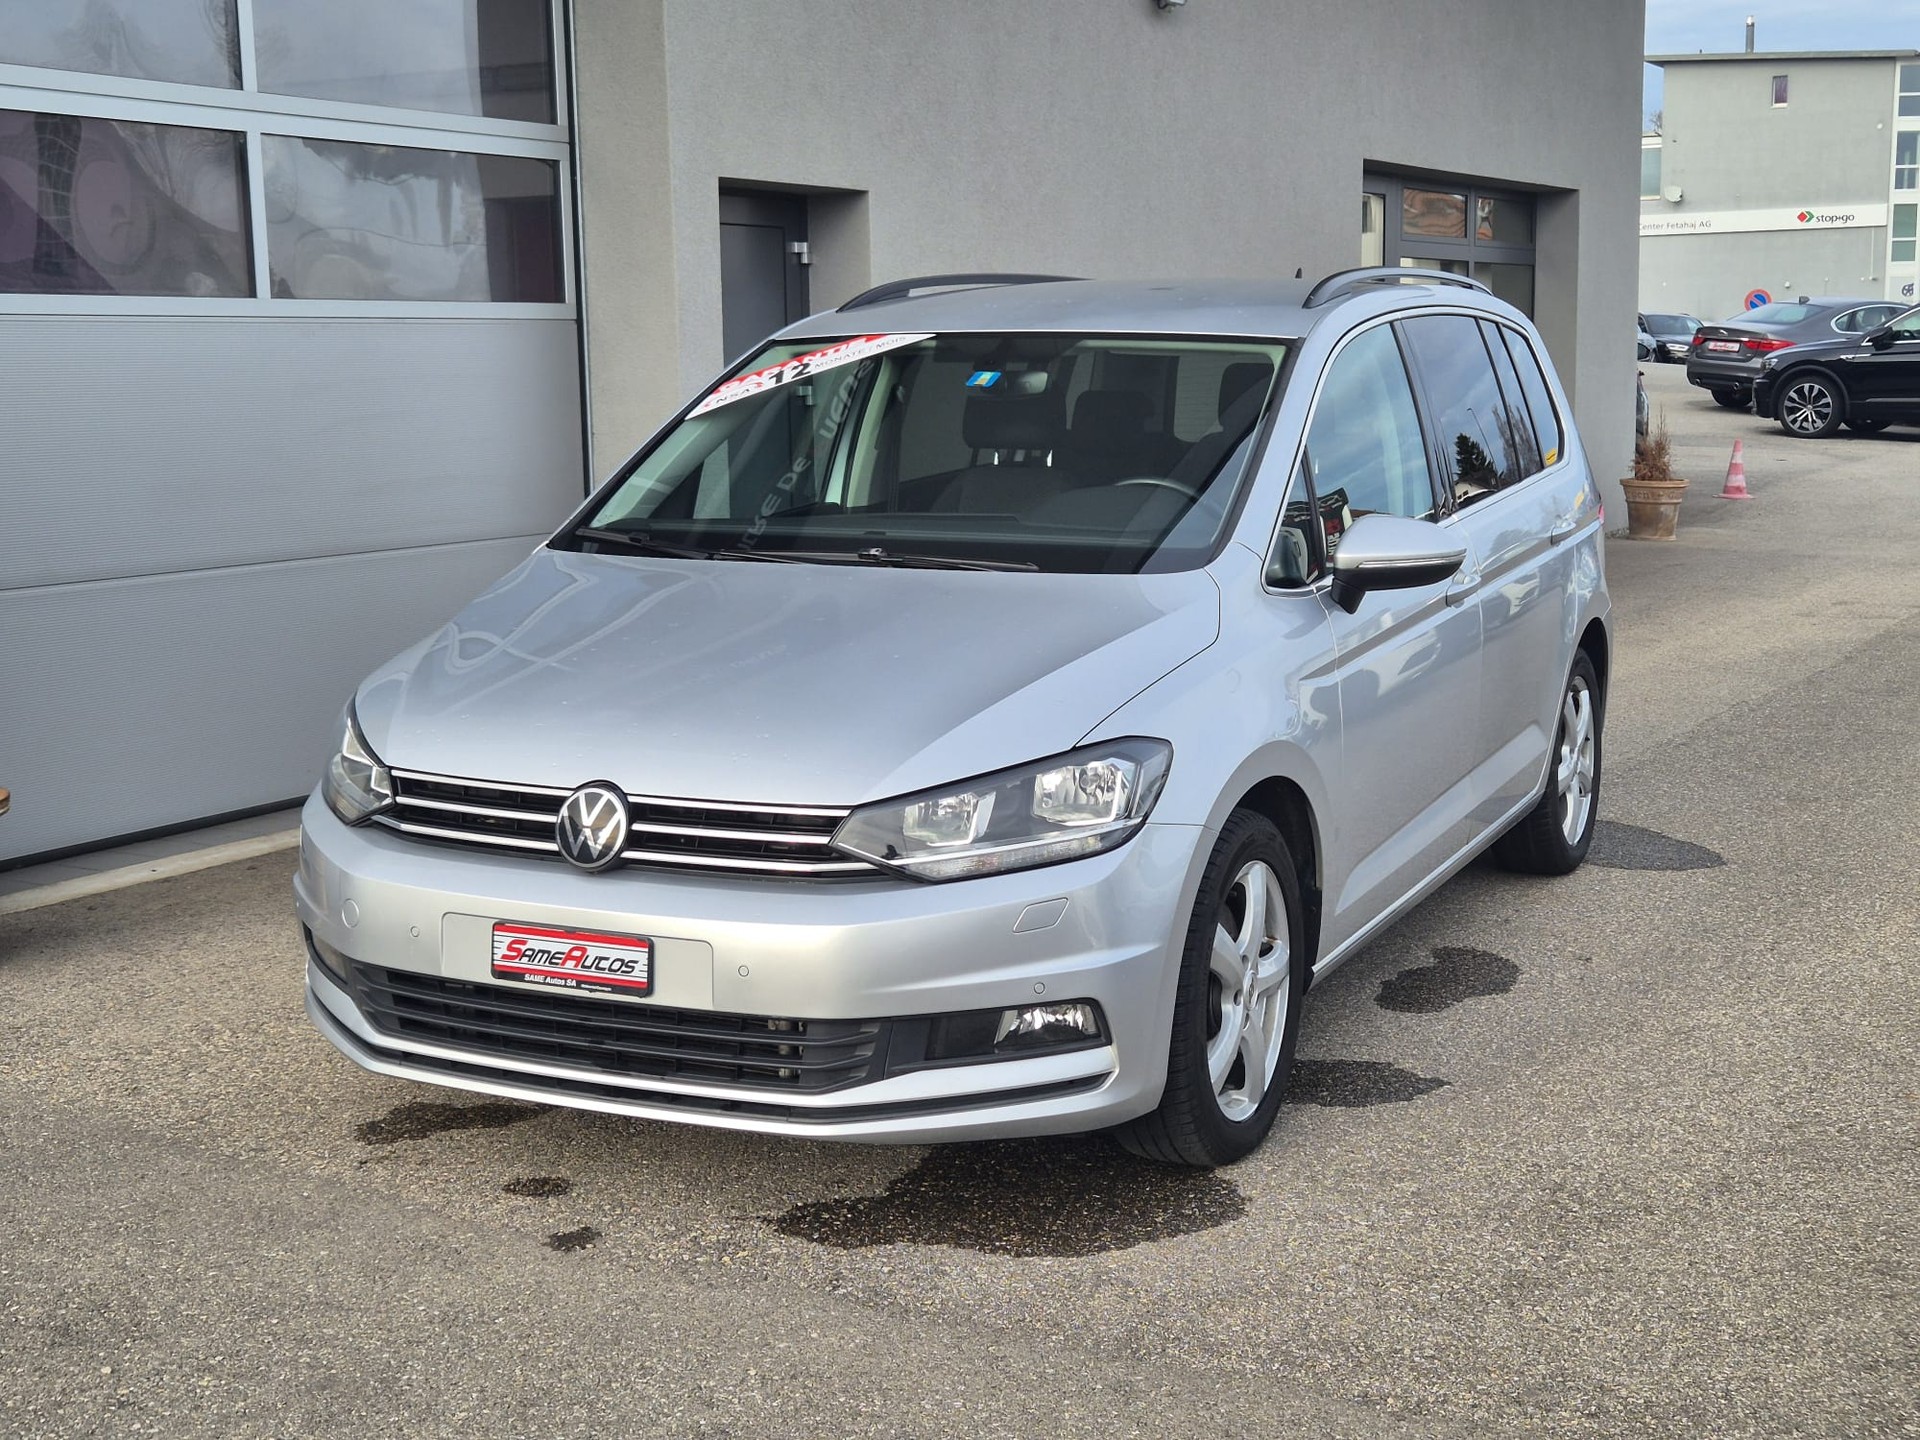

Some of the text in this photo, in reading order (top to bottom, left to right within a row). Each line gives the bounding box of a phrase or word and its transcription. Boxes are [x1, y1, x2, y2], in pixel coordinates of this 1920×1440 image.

[1699, 220, 1712, 228] AG
[768, 362, 811, 385] 12
[815, 350, 864, 368] MONATE
[524, 973, 577, 987] SAME Autos SA
